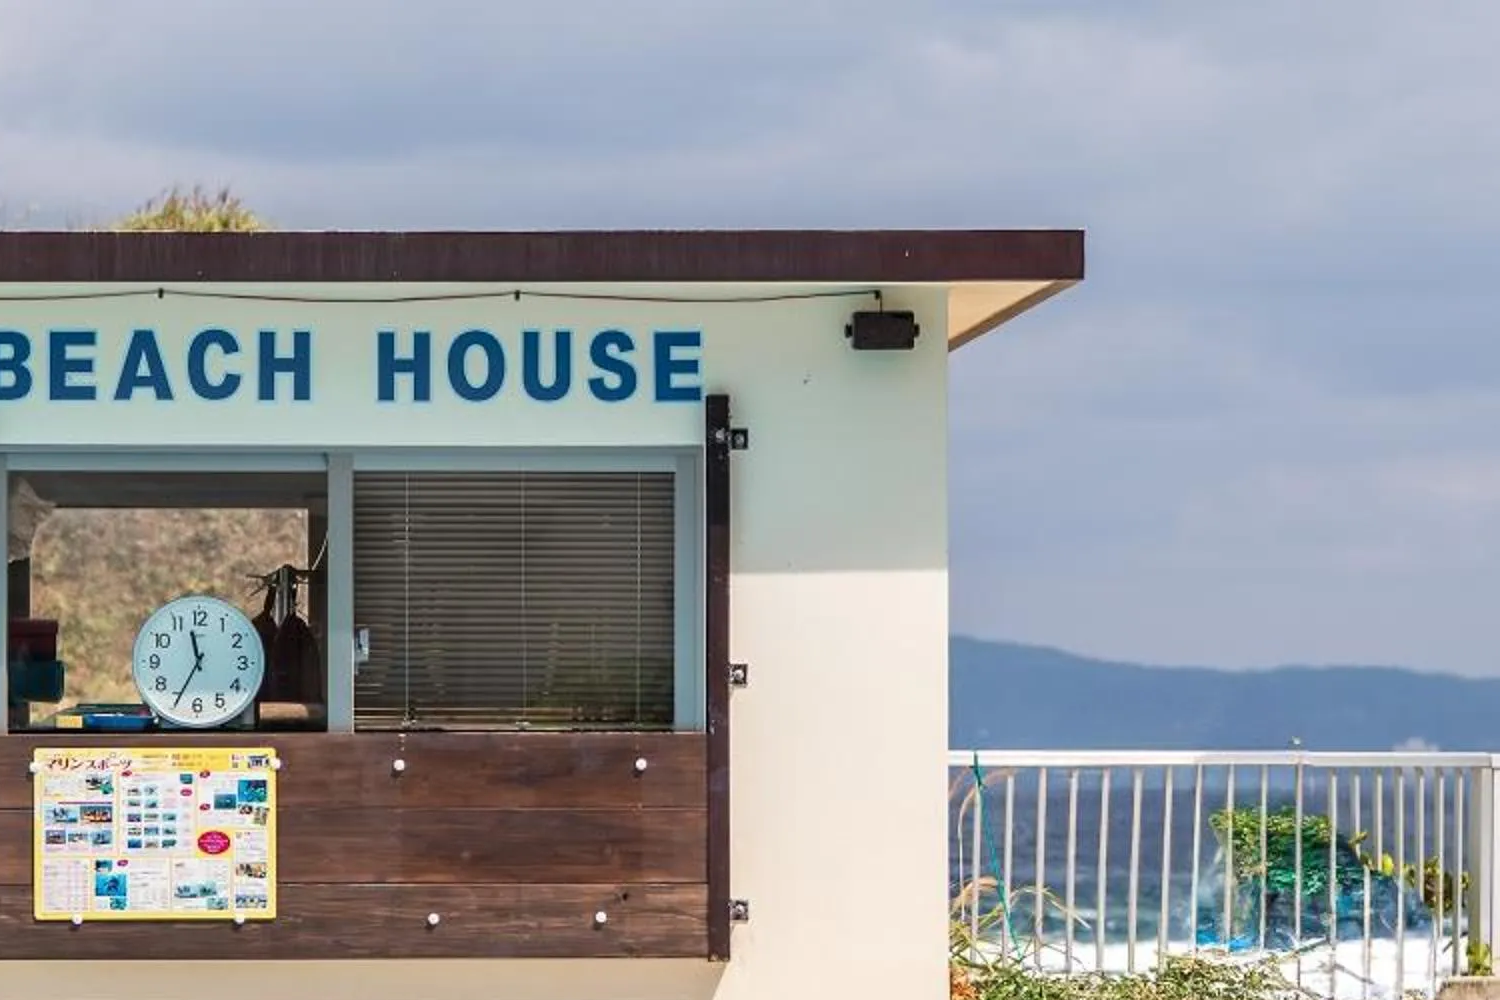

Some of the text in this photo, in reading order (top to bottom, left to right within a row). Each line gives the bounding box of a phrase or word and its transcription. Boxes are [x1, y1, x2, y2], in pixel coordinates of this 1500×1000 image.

[377, 329, 703, 403] HOUSE
[173, 614, 183, 632] 11
[193, 610, 208, 627] 12
[220, 617, 225, 633] 1
[155, 633, 171, 649] 10
[231, 632, 243, 649] 2
[149, 653, 161, 670] 9
[237, 655, 249, 671] 3
[155, 676, 167, 692] 8
[229, 678, 241, 694] 4
[191, 697, 203, 713] 6
[215, 692, 226, 709] 5
[47, 753, 133, 771] マリンスポーツ
